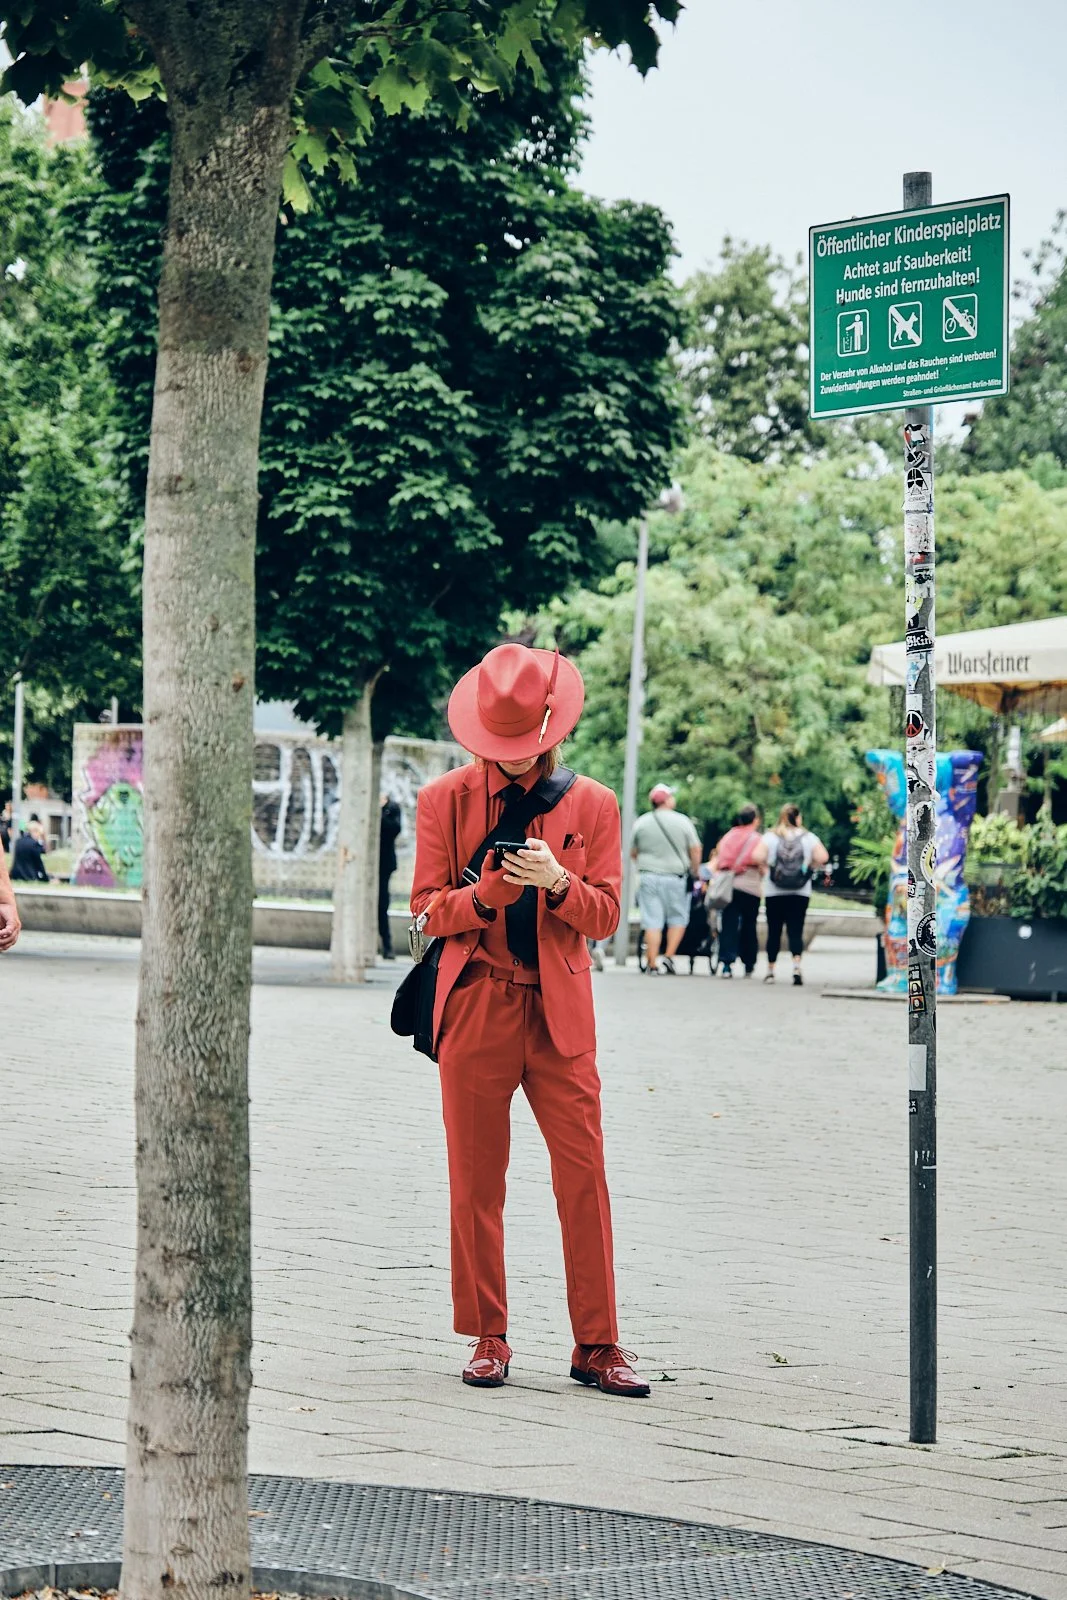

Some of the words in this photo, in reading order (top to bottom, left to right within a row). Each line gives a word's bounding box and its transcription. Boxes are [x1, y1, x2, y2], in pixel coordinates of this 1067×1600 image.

[817, 229, 891, 257] Öffentlicher
[894, 212, 1001, 244] Kinderspielplatz
[843, 260, 880, 280] Achtet
[883, 255, 902, 274] auf
[904, 245, 972, 271] Sauberkeit!
[836, 284, 872, 304] Hunde
[874, 280, 898, 298] sind
[901, 267, 980, 294] fernzuhalten!
[820, 372, 832, 382] Der
[832, 368, 855, 380] Verzehr
[856, 367, 869, 376] von
[869, 362, 893, 375] Alkohol
[894, 360, 906, 371] und
[907, 359, 919, 369] das
[920, 356, 948, 368] Rauchen
[949, 353, 963, 363] sind
[964, 348, 997, 361] verboten!
[820, 379, 881, 394] Zuwiderhandlungen
[881, 375, 905, 386] werden
[905, 370, 939, 385] geahndet!
